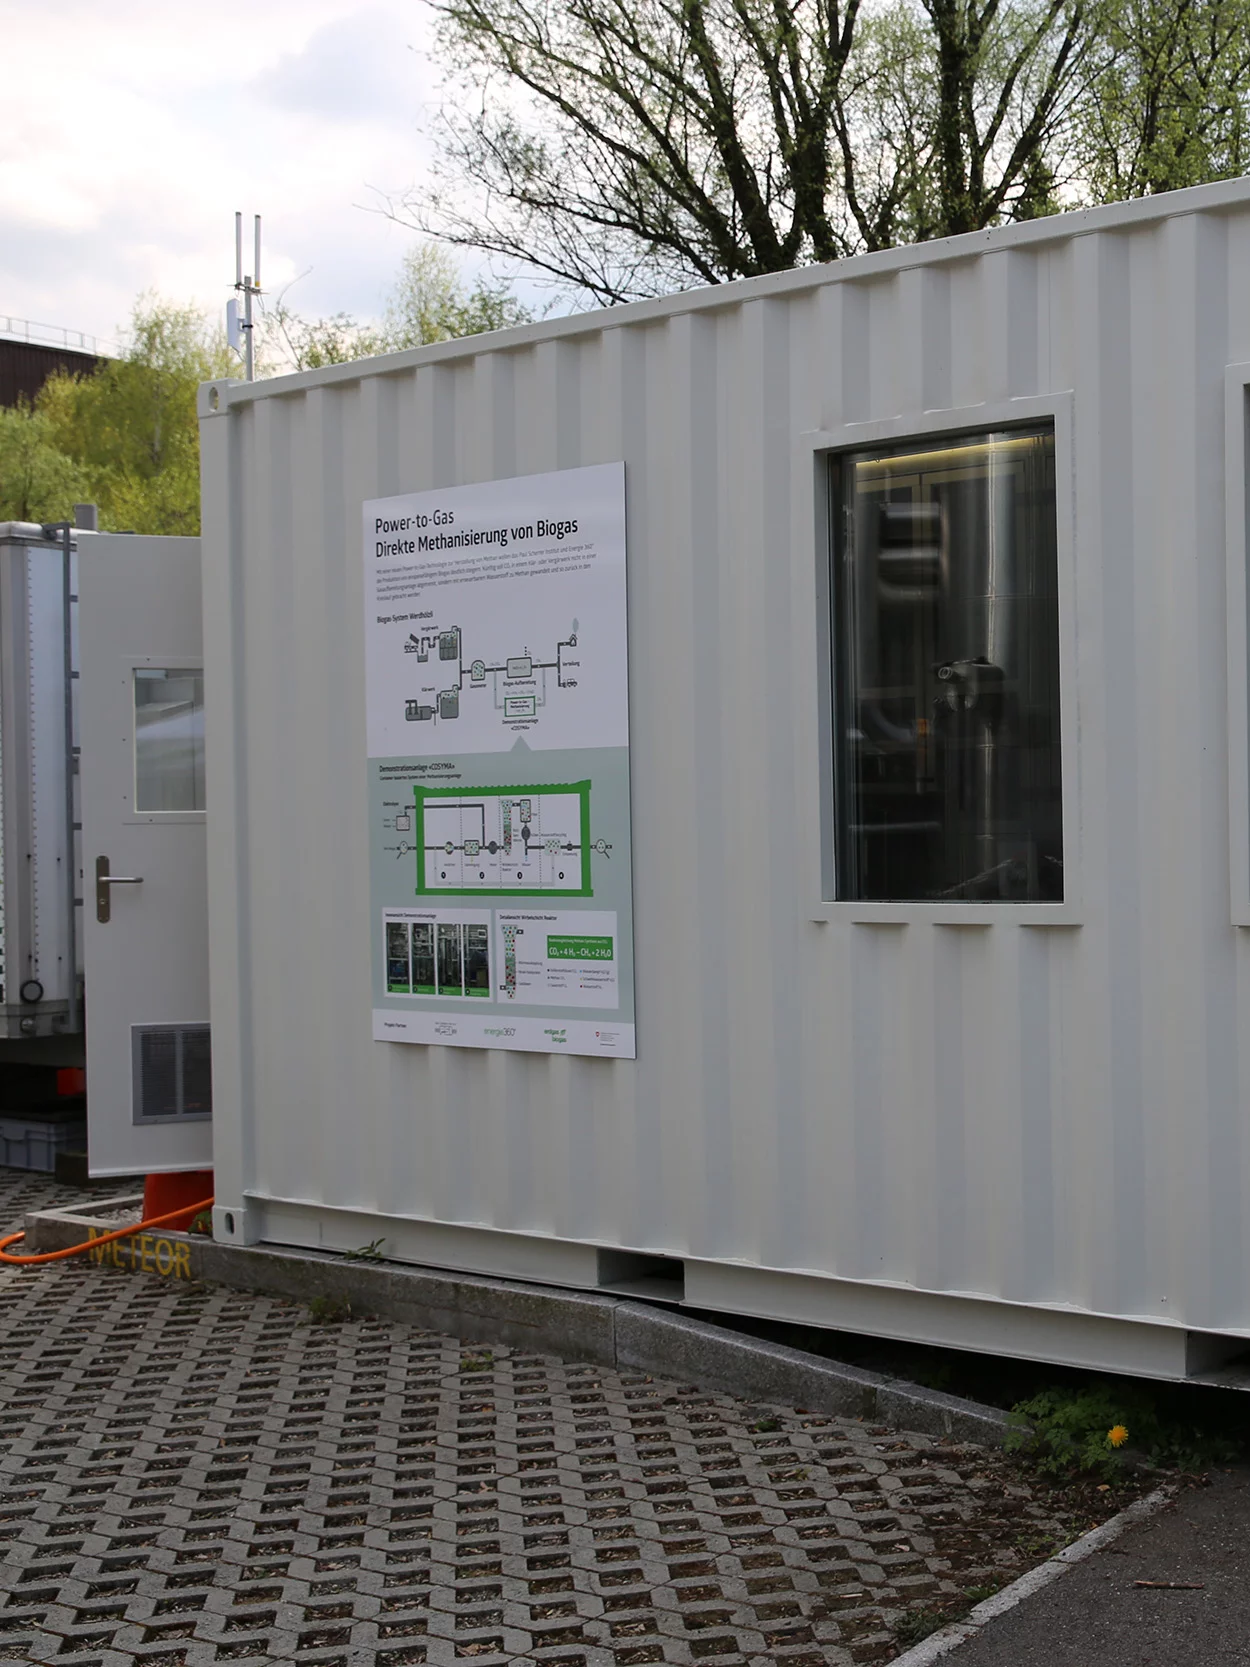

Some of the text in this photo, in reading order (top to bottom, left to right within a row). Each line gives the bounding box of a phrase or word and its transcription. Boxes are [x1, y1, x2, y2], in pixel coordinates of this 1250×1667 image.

[375, 509, 454, 534] Power-to-Gas
[376, 518, 578, 558] Direkte Methanisierung von Biogas
[88, 1227, 192, 1278] METEOR
